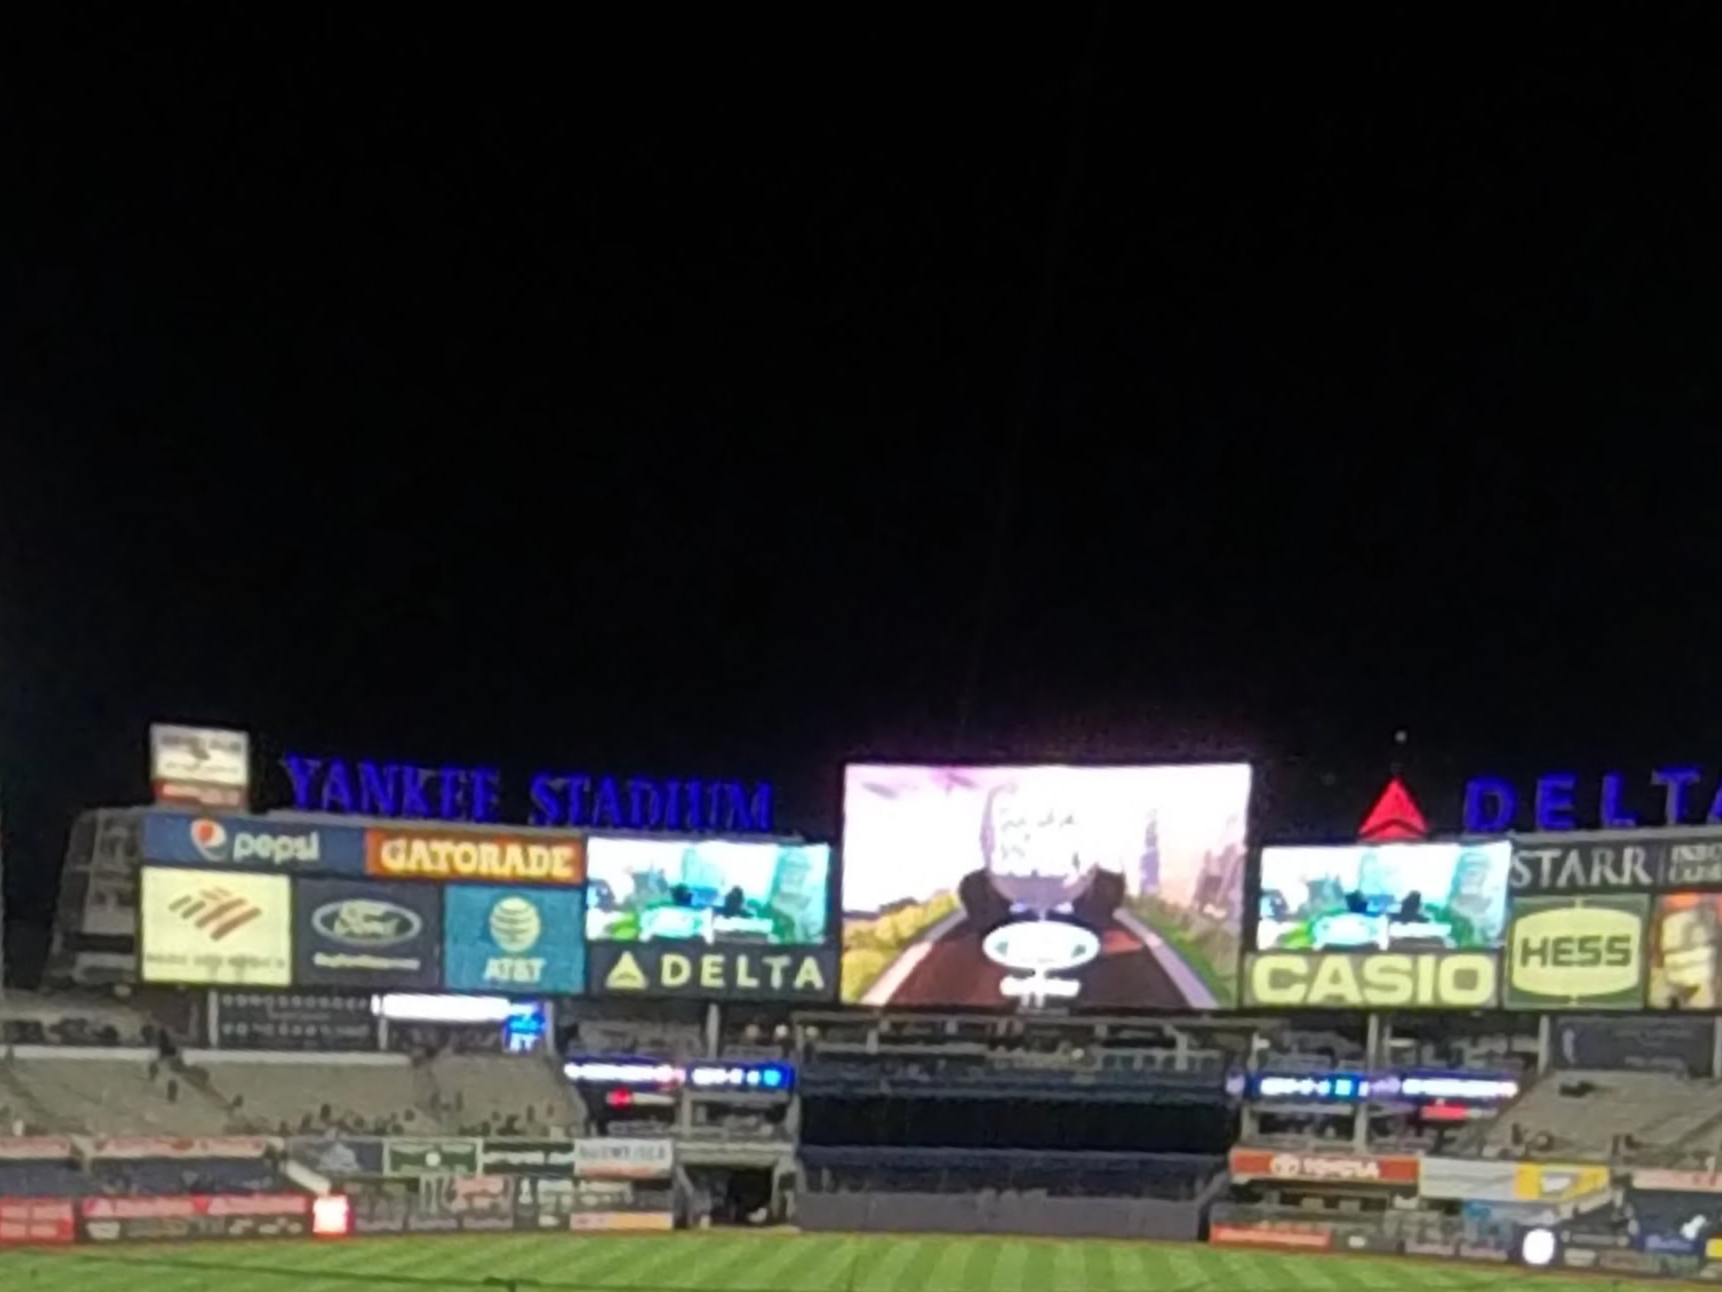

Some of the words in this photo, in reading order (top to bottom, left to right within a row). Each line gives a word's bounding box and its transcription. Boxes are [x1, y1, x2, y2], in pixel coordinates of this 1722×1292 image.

[281, 752, 501, 823] YANKEE
[527, 771, 775, 831] STADIUM
[232, 828, 320, 865] pepsi
[380, 837, 575, 878] GATORADE
[1510, 845, 1653, 889] STARR
[332, 901, 401, 937] Ford
[483, 956, 548, 983] AT&T
[661, 946, 826, 991] DELTA
[1519, 934, 1633, 968] HESS
[1251, 953, 1498, 1006] CASIO
